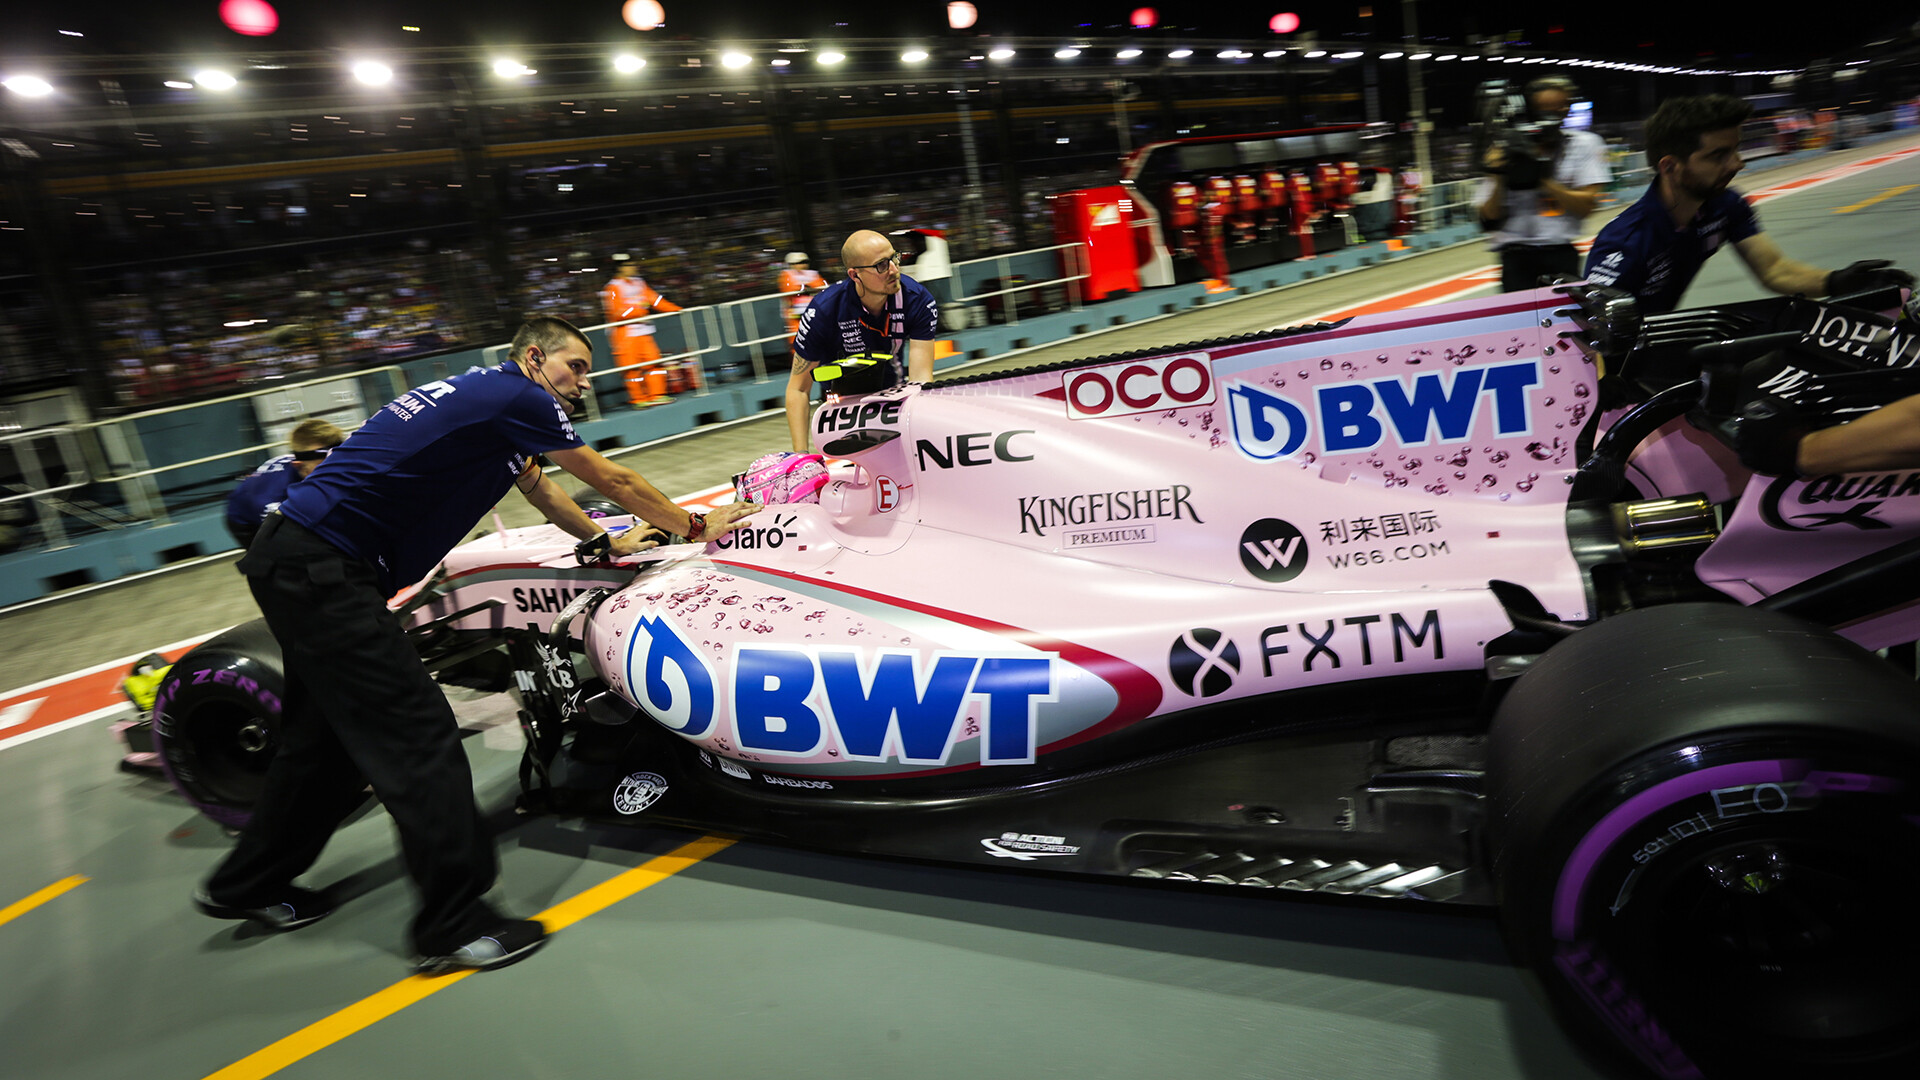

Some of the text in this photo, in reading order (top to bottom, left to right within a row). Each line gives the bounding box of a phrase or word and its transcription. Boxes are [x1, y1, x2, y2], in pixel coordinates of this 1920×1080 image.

[1068, 356, 1211, 416] OCO
[817, 400, 901, 434] HYPE
[1316, 361, 1541, 453] BWT
[915, 430, 1036, 472] NEC
[877, 479, 894, 509] E
[1018, 484, 1206, 537] KINGFISHER
[715, 526, 784, 550] Claro
[1071, 528, 1147, 546] PREMIUM
[1319, 510, 1442, 547] 利来国际
[1326, 540, 1452, 570] W66.COM
[512, 587, 612, 614] SAHA
[1260, 609, 1444, 678] FXTM
[191, 668, 283, 714] ZERO
[735, 646, 1055, 763] BWT
[762, 773, 834, 790] BARBADOS
